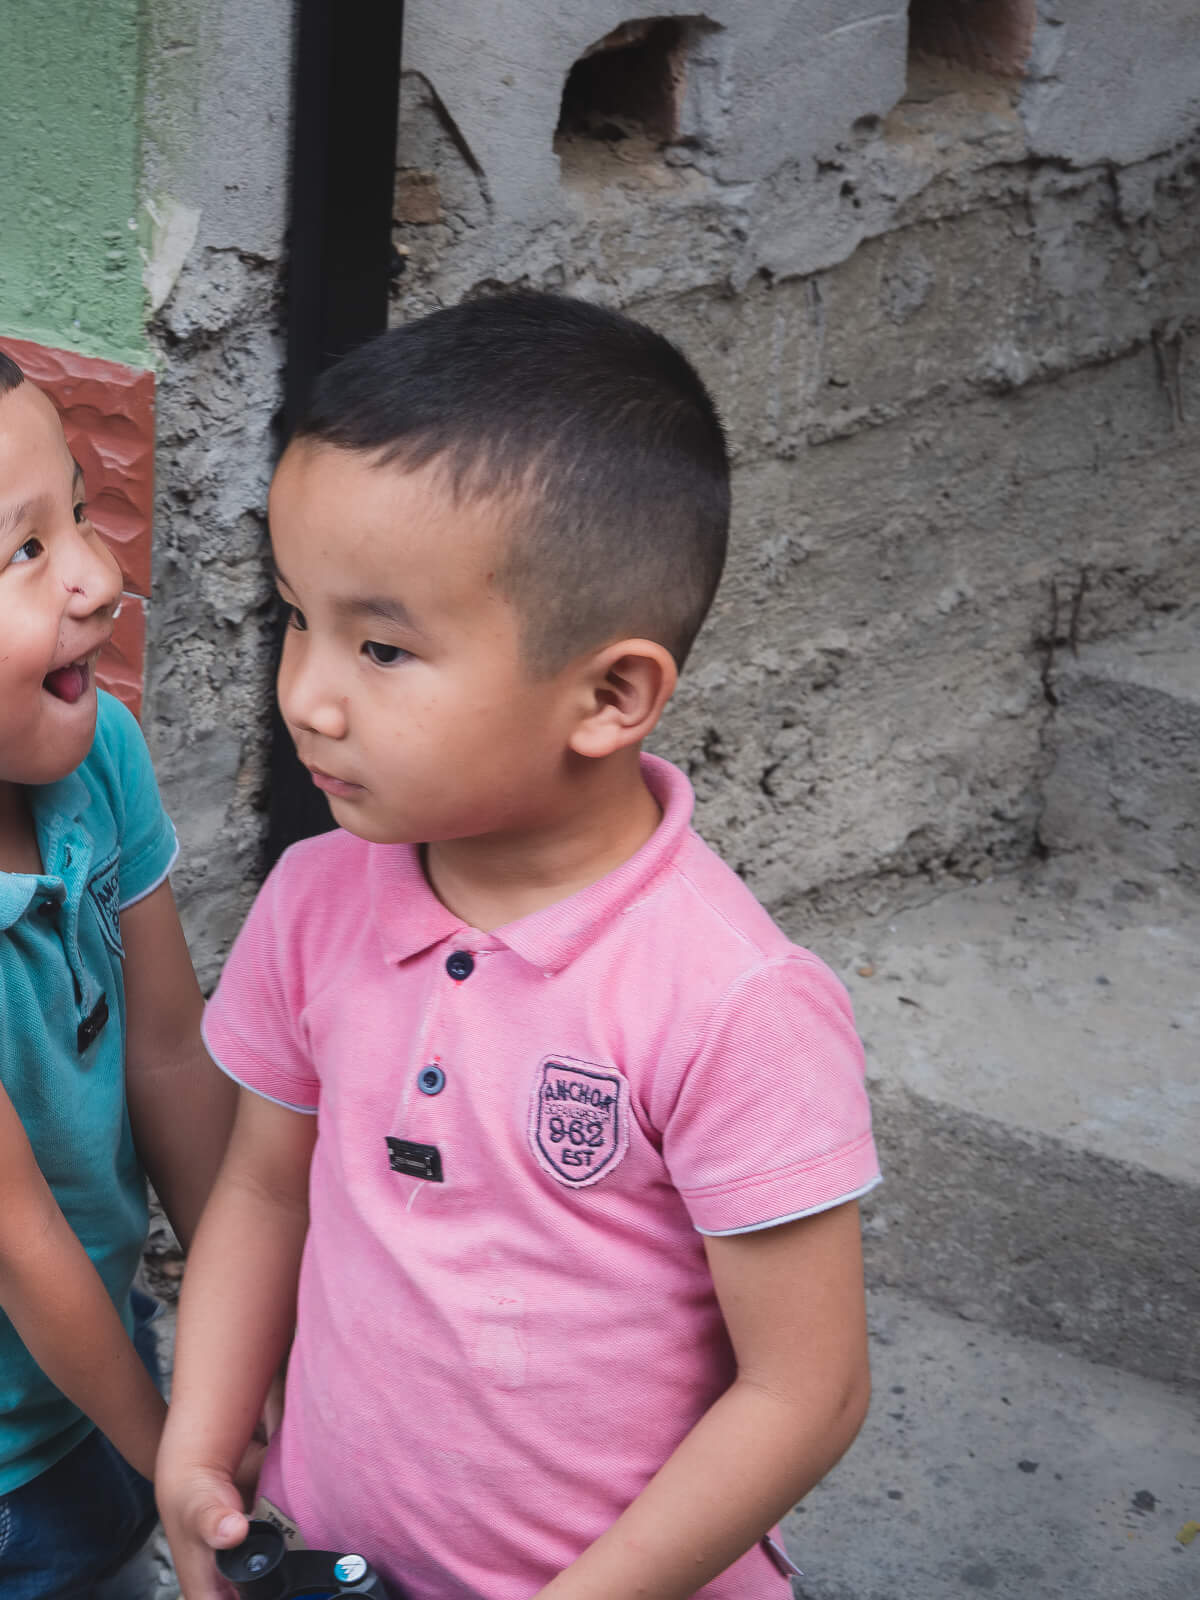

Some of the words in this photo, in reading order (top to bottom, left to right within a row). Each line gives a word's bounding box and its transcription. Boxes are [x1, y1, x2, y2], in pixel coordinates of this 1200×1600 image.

[544, 1080, 617, 1113] ANCHOR
[549, 1117, 604, 1147] 962
[561, 1148, 595, 1166] EST
